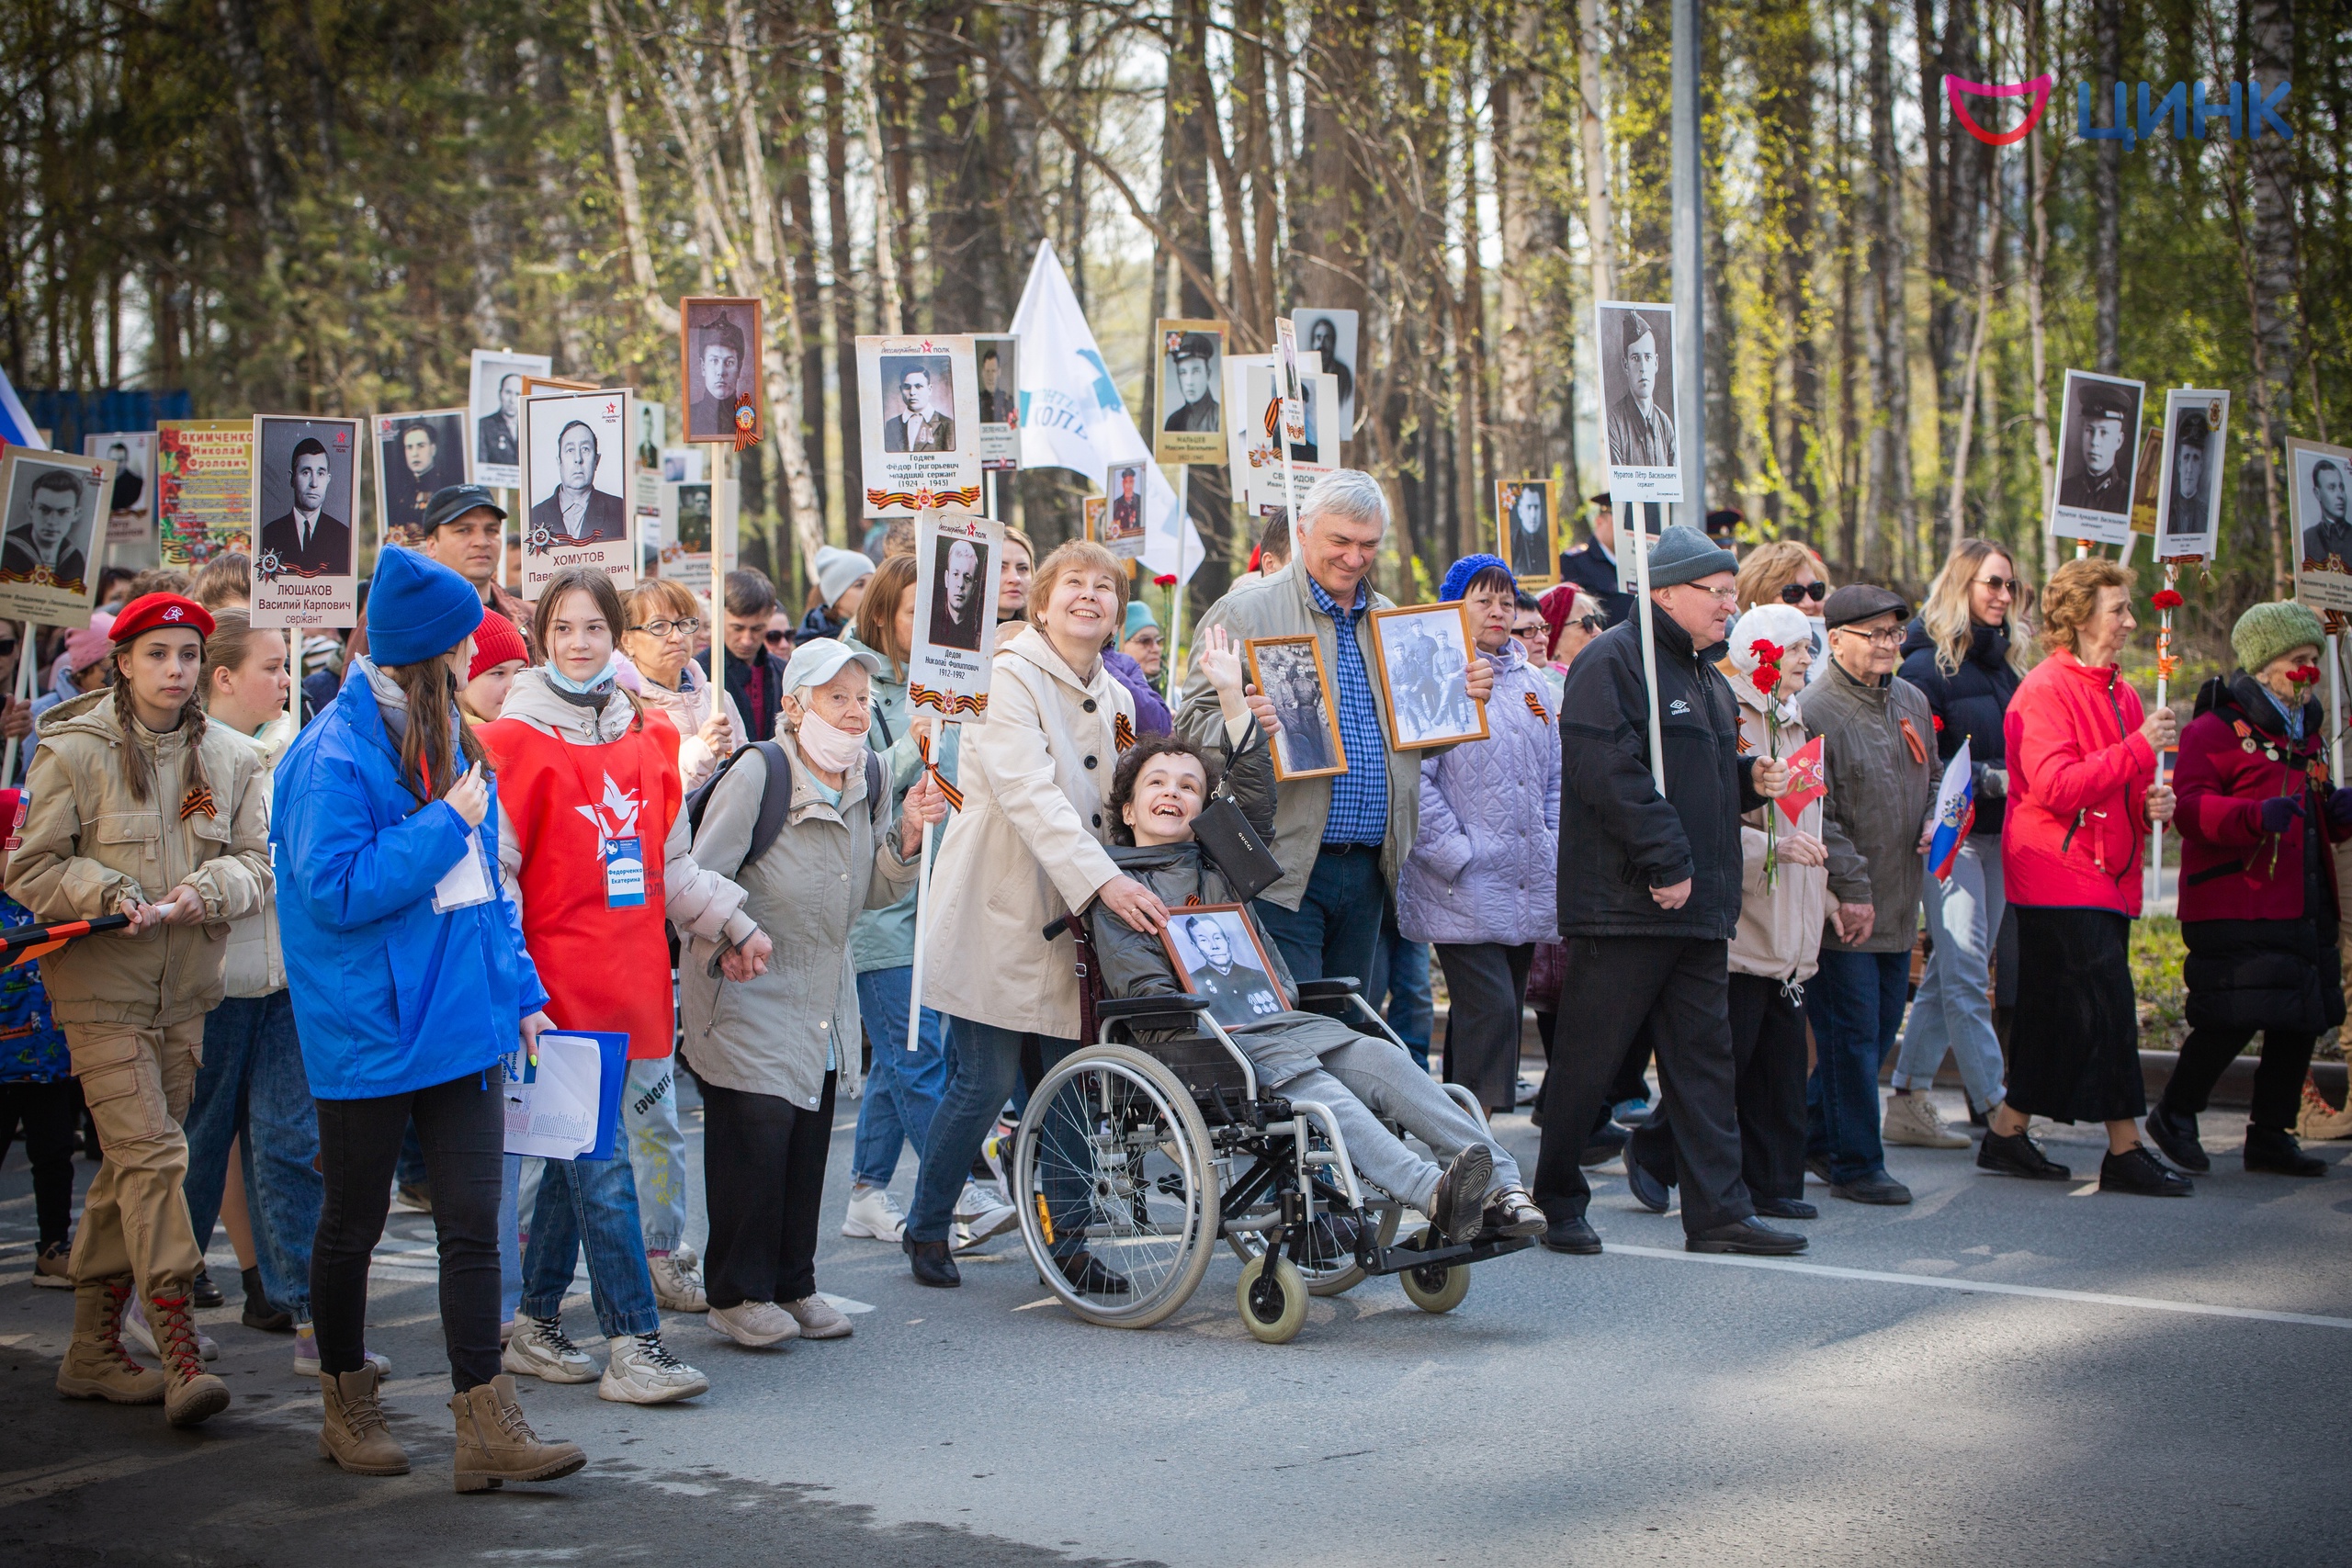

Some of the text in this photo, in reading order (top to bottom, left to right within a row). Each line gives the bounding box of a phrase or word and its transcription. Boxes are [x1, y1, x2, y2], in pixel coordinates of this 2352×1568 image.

[180, 433, 254, 443] ЯКИМЧЕНКО
[192, 445, 243, 455] Николай
[189, 459, 247, 469] Фролович
[886, 462, 959, 471] Фёдор Григорьевич
[888, 470, 924, 479] младший
[1272, 472, 1316, 483] СВИДОВ
[1613, 470, 1678, 480] Муратов Пётр Васильевич
[898, 479, 918, 488] (1924
[553, 551, 605, 567] ХОМУТОВ
[528, 571, 553, 582] Паве
[277, 584, 333, 596] ЛЮШАКОВ
[258, 598, 351, 613] Василий Карпович
[285, 615, 322, 626] сержант
[944, 649, 962, 660] Дедов
[924, 656, 979, 672] Николай Филиппович
[939, 668, 966, 680] 1912-1992
[607, 868, 643, 876] Федорченко
[611, 876, 641, 885] Екатерина
[634, 1071, 672, 1115] EDUCATE
